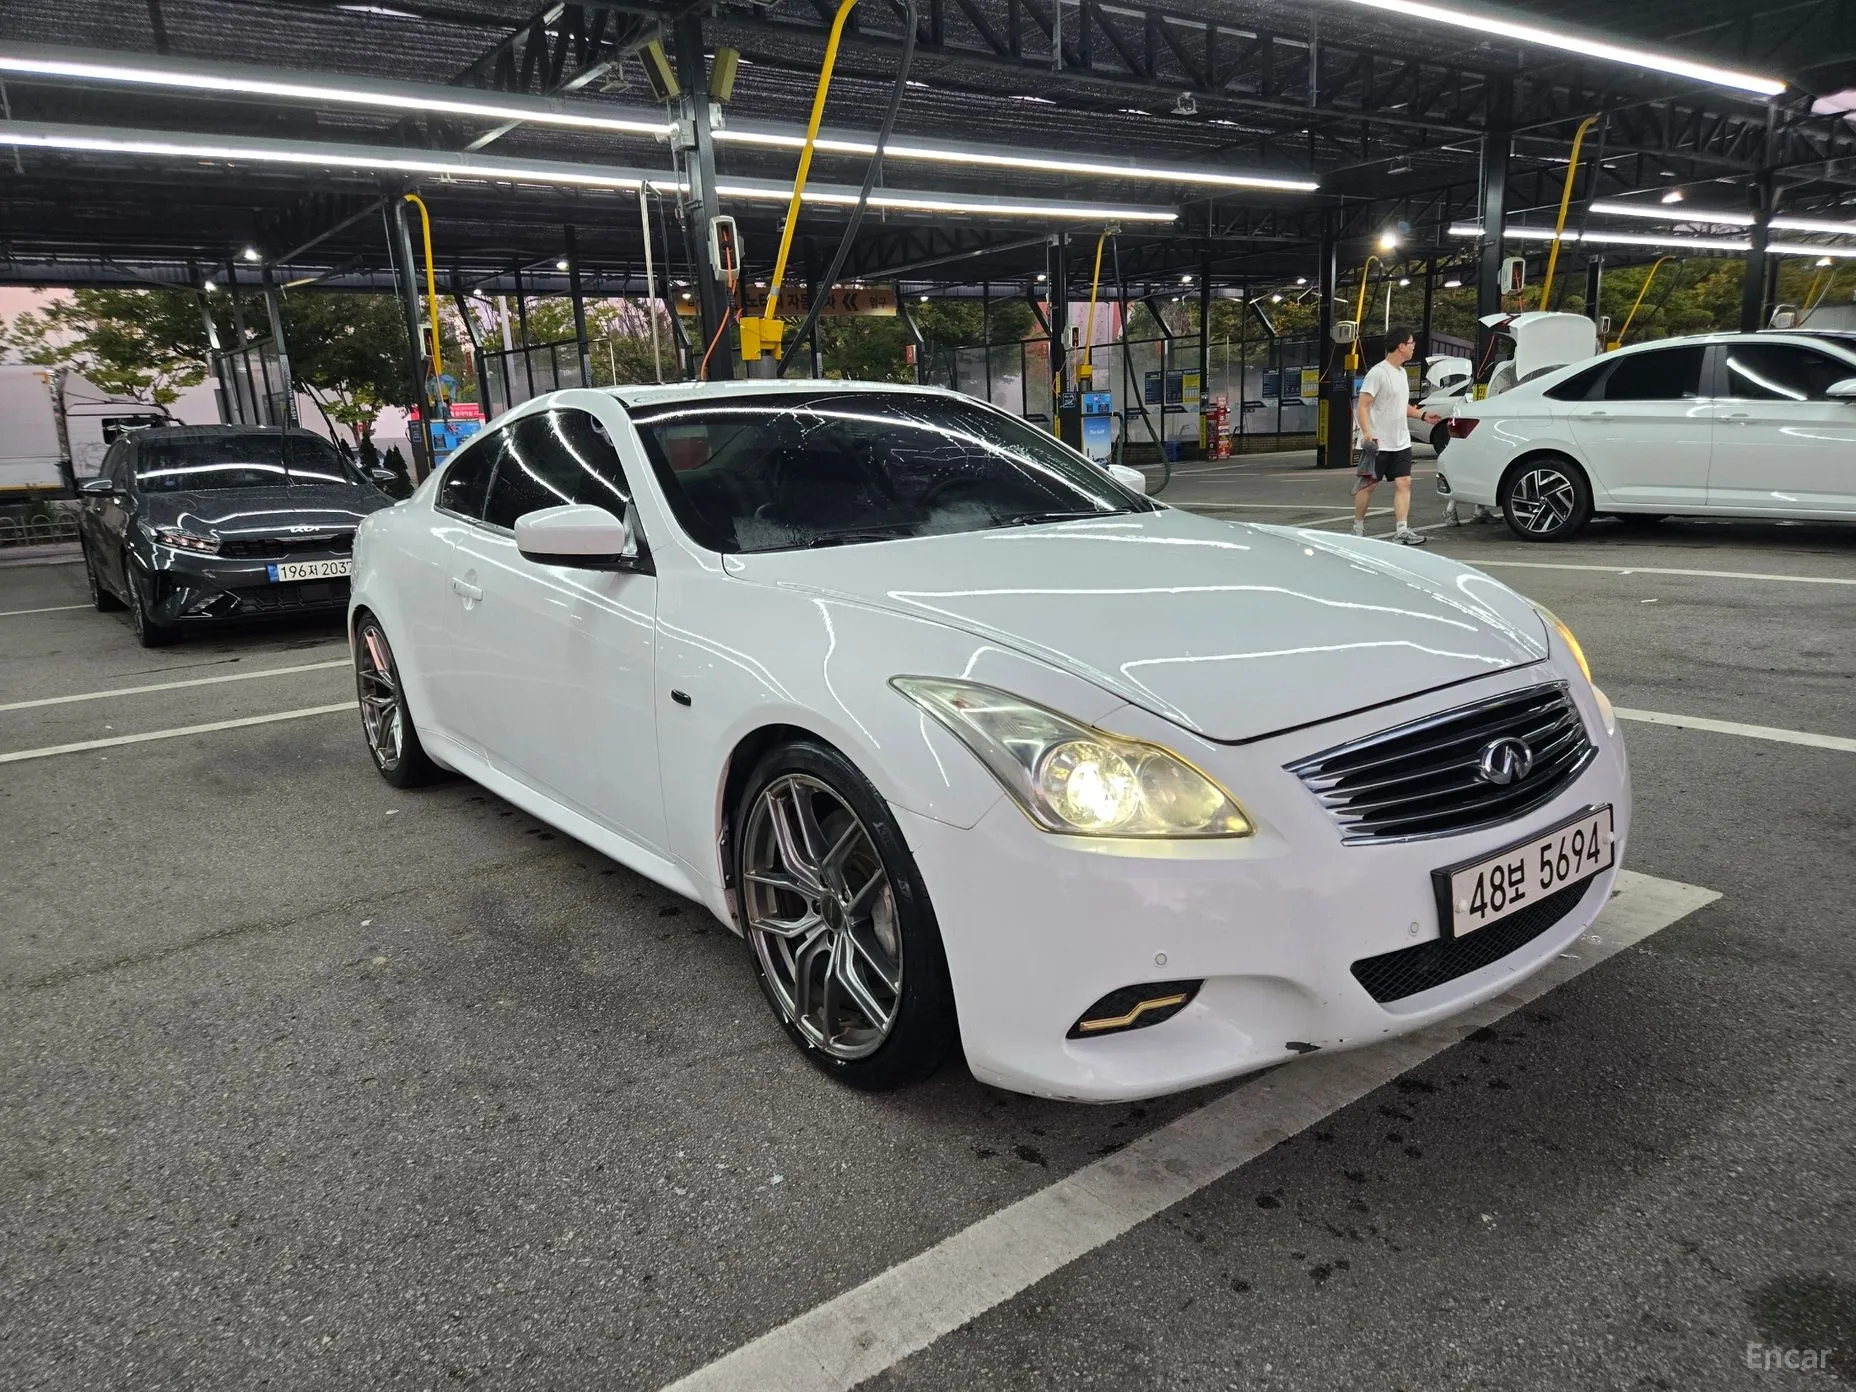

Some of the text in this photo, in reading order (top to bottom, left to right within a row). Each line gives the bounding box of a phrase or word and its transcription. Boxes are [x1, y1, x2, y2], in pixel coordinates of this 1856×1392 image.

[868, 294, 887, 309] 입구
[281, 564, 318, 579] 196저
[1469, 821, 1601, 919] 48보 5694
